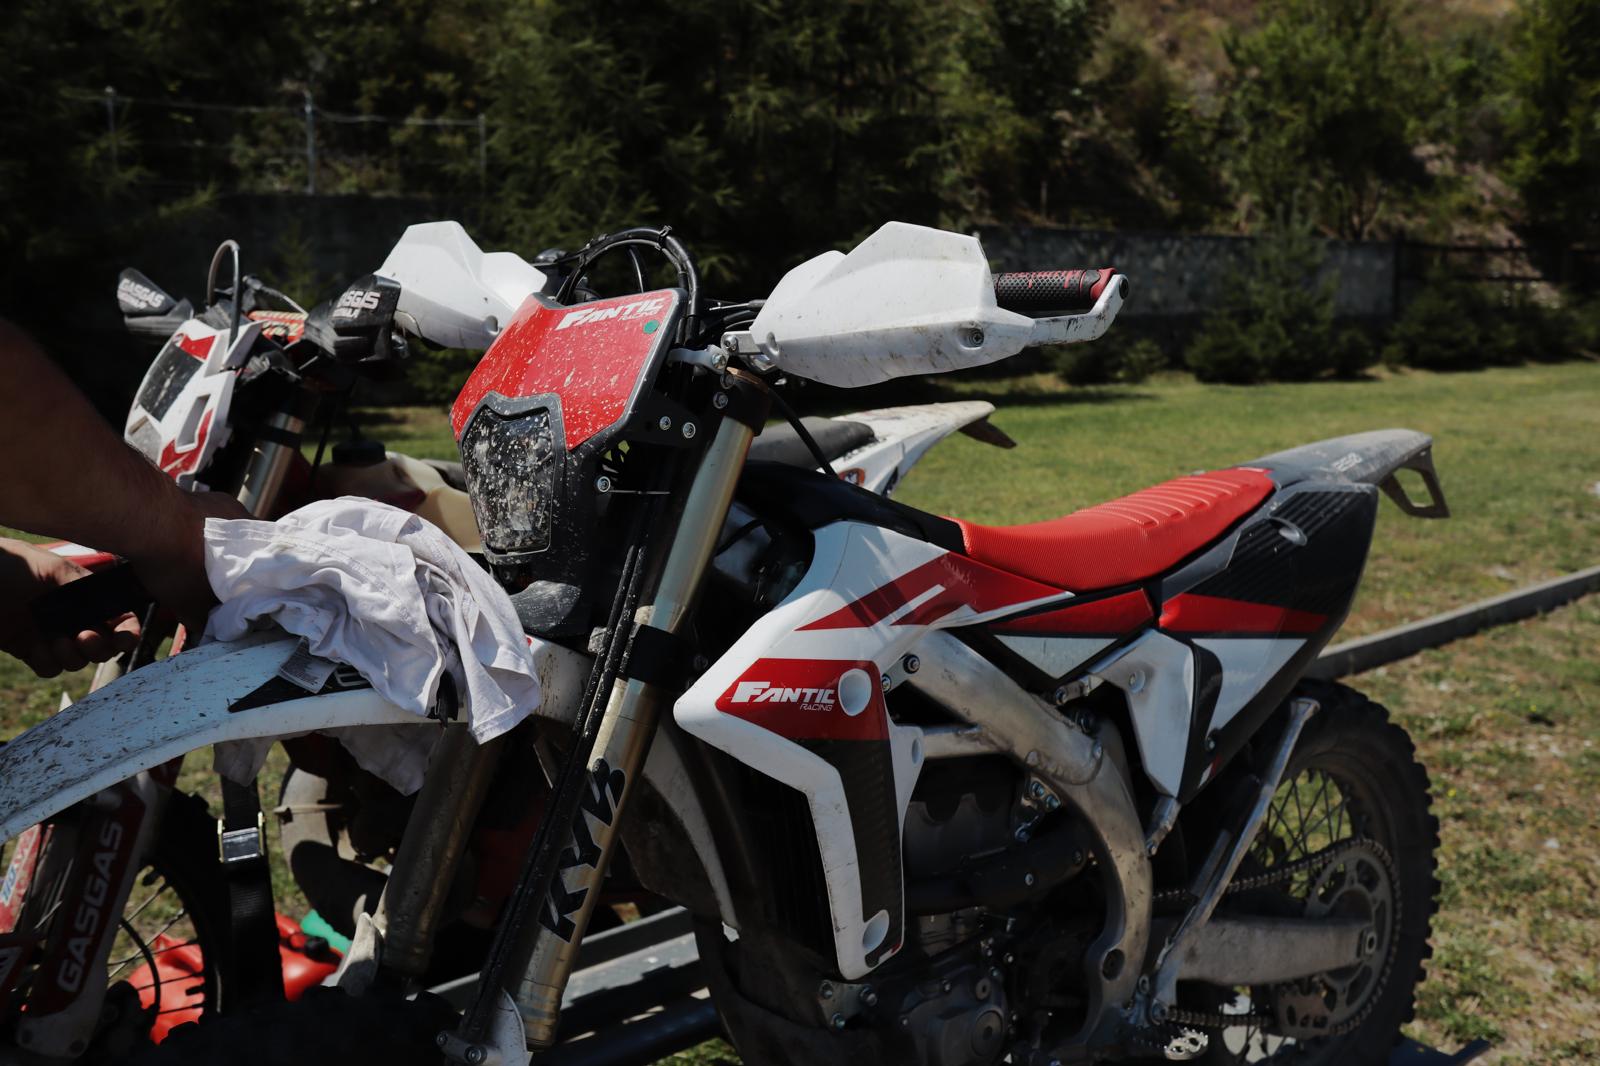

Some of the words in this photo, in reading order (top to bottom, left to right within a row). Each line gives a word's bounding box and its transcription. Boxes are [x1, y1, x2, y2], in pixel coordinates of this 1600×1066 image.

[118, 278, 165, 308] GASGAS
[555, 298, 665, 331] FANTIC
[731, 681, 835, 703] FANTIC
[799, 703, 834, 712] RACING
[538, 758, 626, 944] KYB
[58, 820, 123, 993] GASGAS
